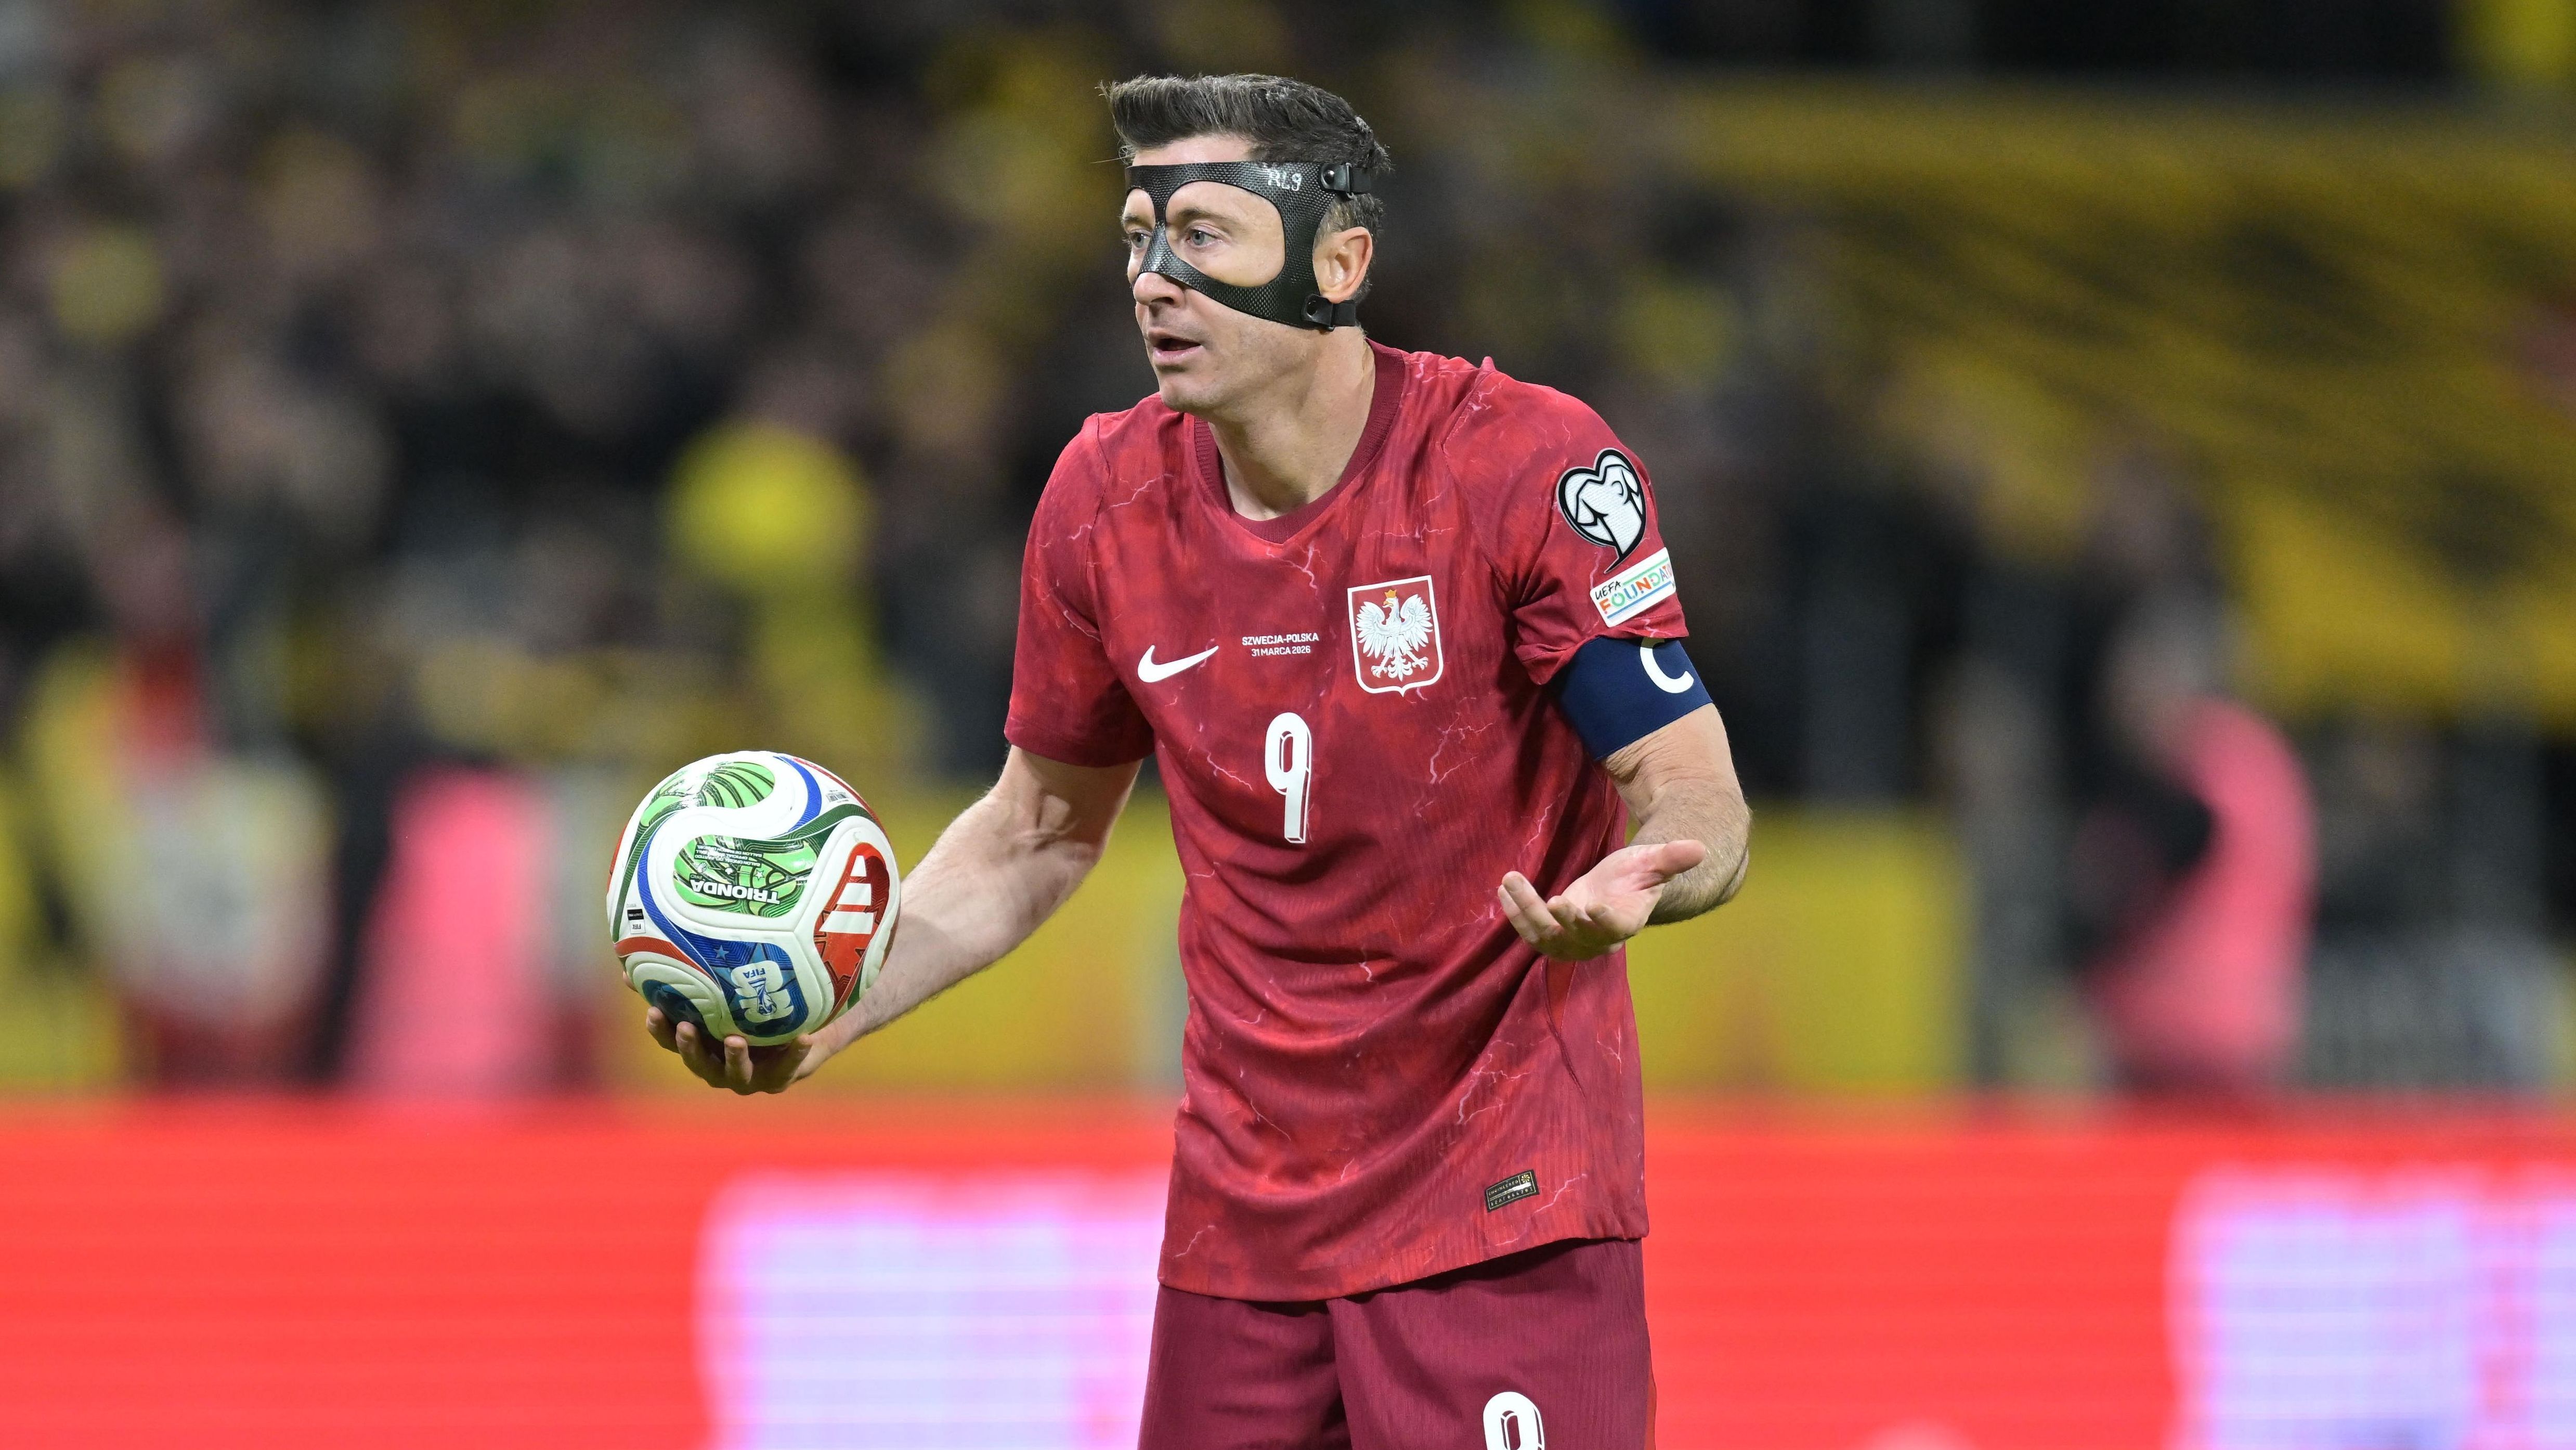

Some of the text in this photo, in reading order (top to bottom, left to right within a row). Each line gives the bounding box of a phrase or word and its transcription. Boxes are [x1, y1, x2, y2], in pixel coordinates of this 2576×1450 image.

[1595, 580, 1621, 600] UEFA
[1242, 632, 1319, 646] SZWECJA-POLSKA
[1251, 645, 1311, 657] 31 MARCA 2026
[1265, 712, 1312, 844] 9
[690, 879, 780, 905] TRIONDA
[743, 968, 766, 978] FIFA
